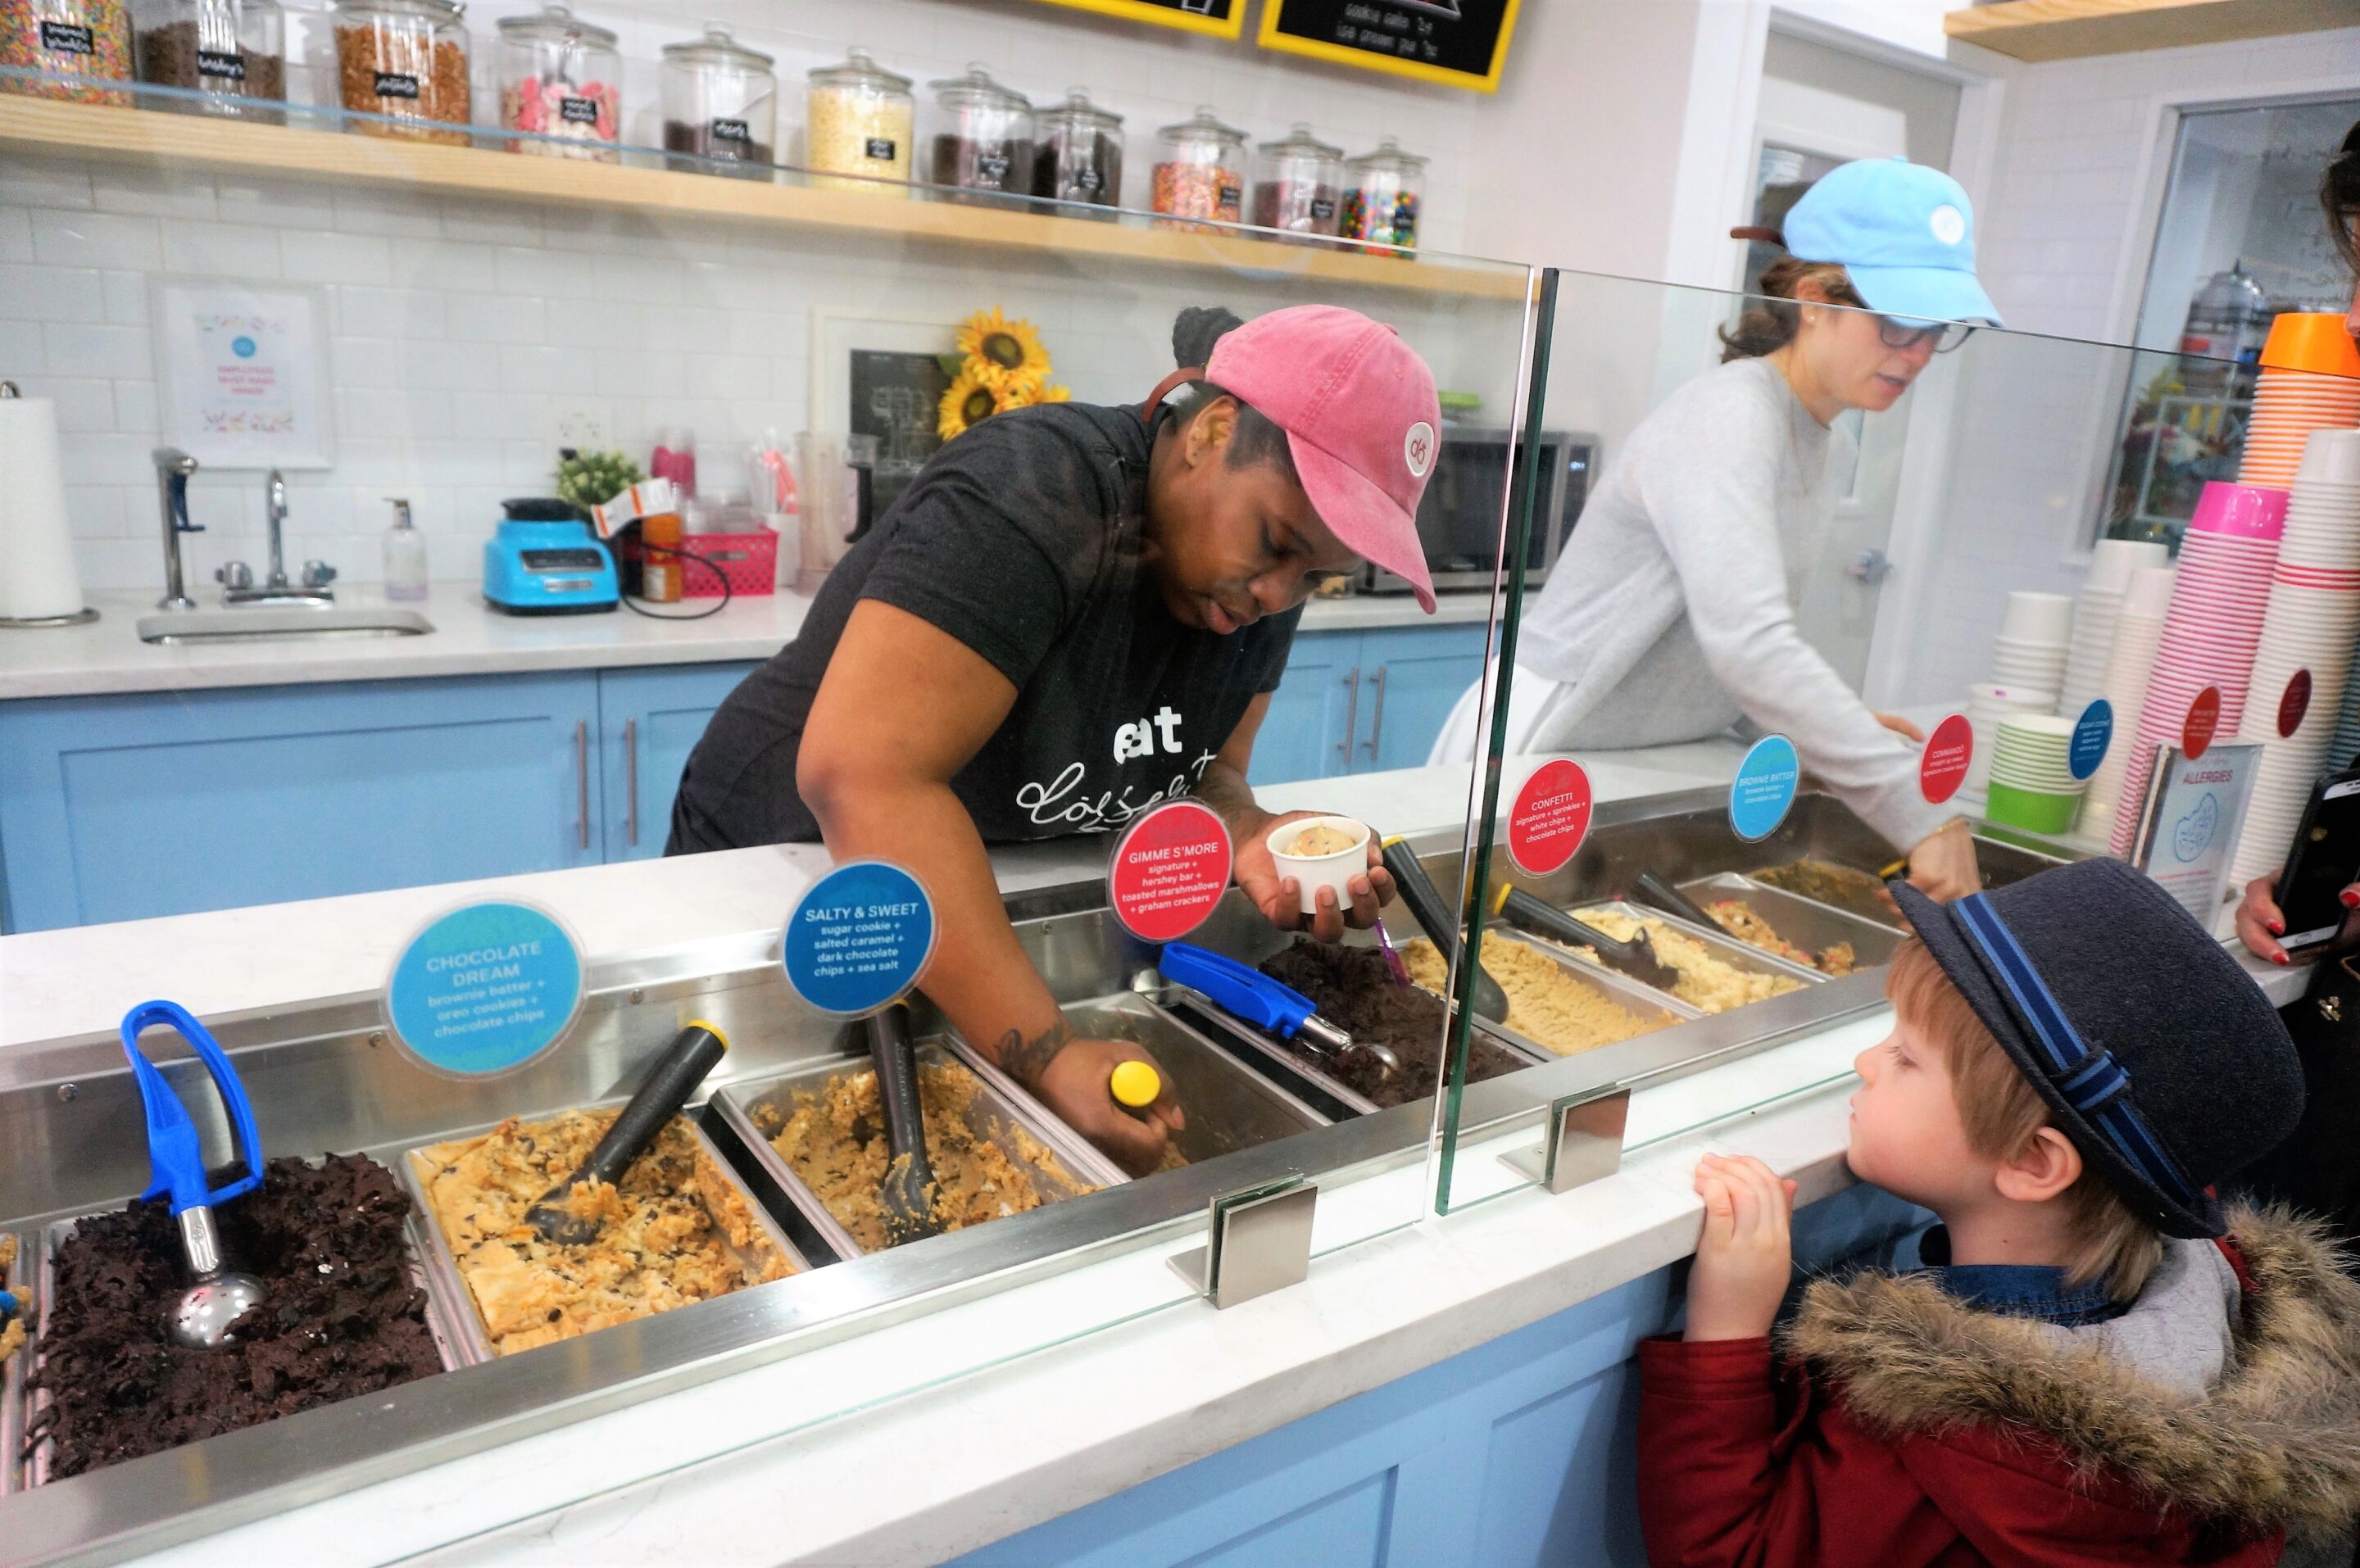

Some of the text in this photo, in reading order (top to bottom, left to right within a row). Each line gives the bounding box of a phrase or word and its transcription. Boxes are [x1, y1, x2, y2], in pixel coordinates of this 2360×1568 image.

[1739, 771, 1795, 786] BROWNIE BATTER
[2182, 769, 2234, 785] ALLERGIES
[1532, 792, 1573, 811] CONFETTI
[1516, 812, 1546, 827] signature
[1552, 803, 1581, 817] sprinkles
[1530, 820, 1547, 832] white
[1549, 817, 1566, 827] chips
[1526, 824, 1575, 843] chocolate chips
[1129, 842, 1219, 864] GIMME S'MORE
[1148, 861, 1190, 875] signature
[1142, 875, 1177, 887] hershey
[1179, 872, 1194, 882] bar
[1122, 881, 1219, 902] toasted marshmallows
[806, 903, 919, 922] SALTY & SWEET
[1138, 900, 1172, 914] graham
[1173, 895, 1210, 907] crackers
[821, 925, 852, 937] sugar
[855, 921, 891, 932] cookie
[814, 937, 849, 949] salted
[851, 934, 895, 946] caramel
[426, 941, 542, 972] CHOCOLATE
[817, 948, 899, 963] dark chocolate
[452, 963, 521, 986] DREAM
[814, 965, 845, 977] chips
[857, 963, 876, 972] sea
[878, 960, 899, 971] salt
[428, 980, 545, 1008] brownie batter +
[437, 996, 538, 1022] oreo cookies +
[434, 1009, 545, 1038] chocolate chips
